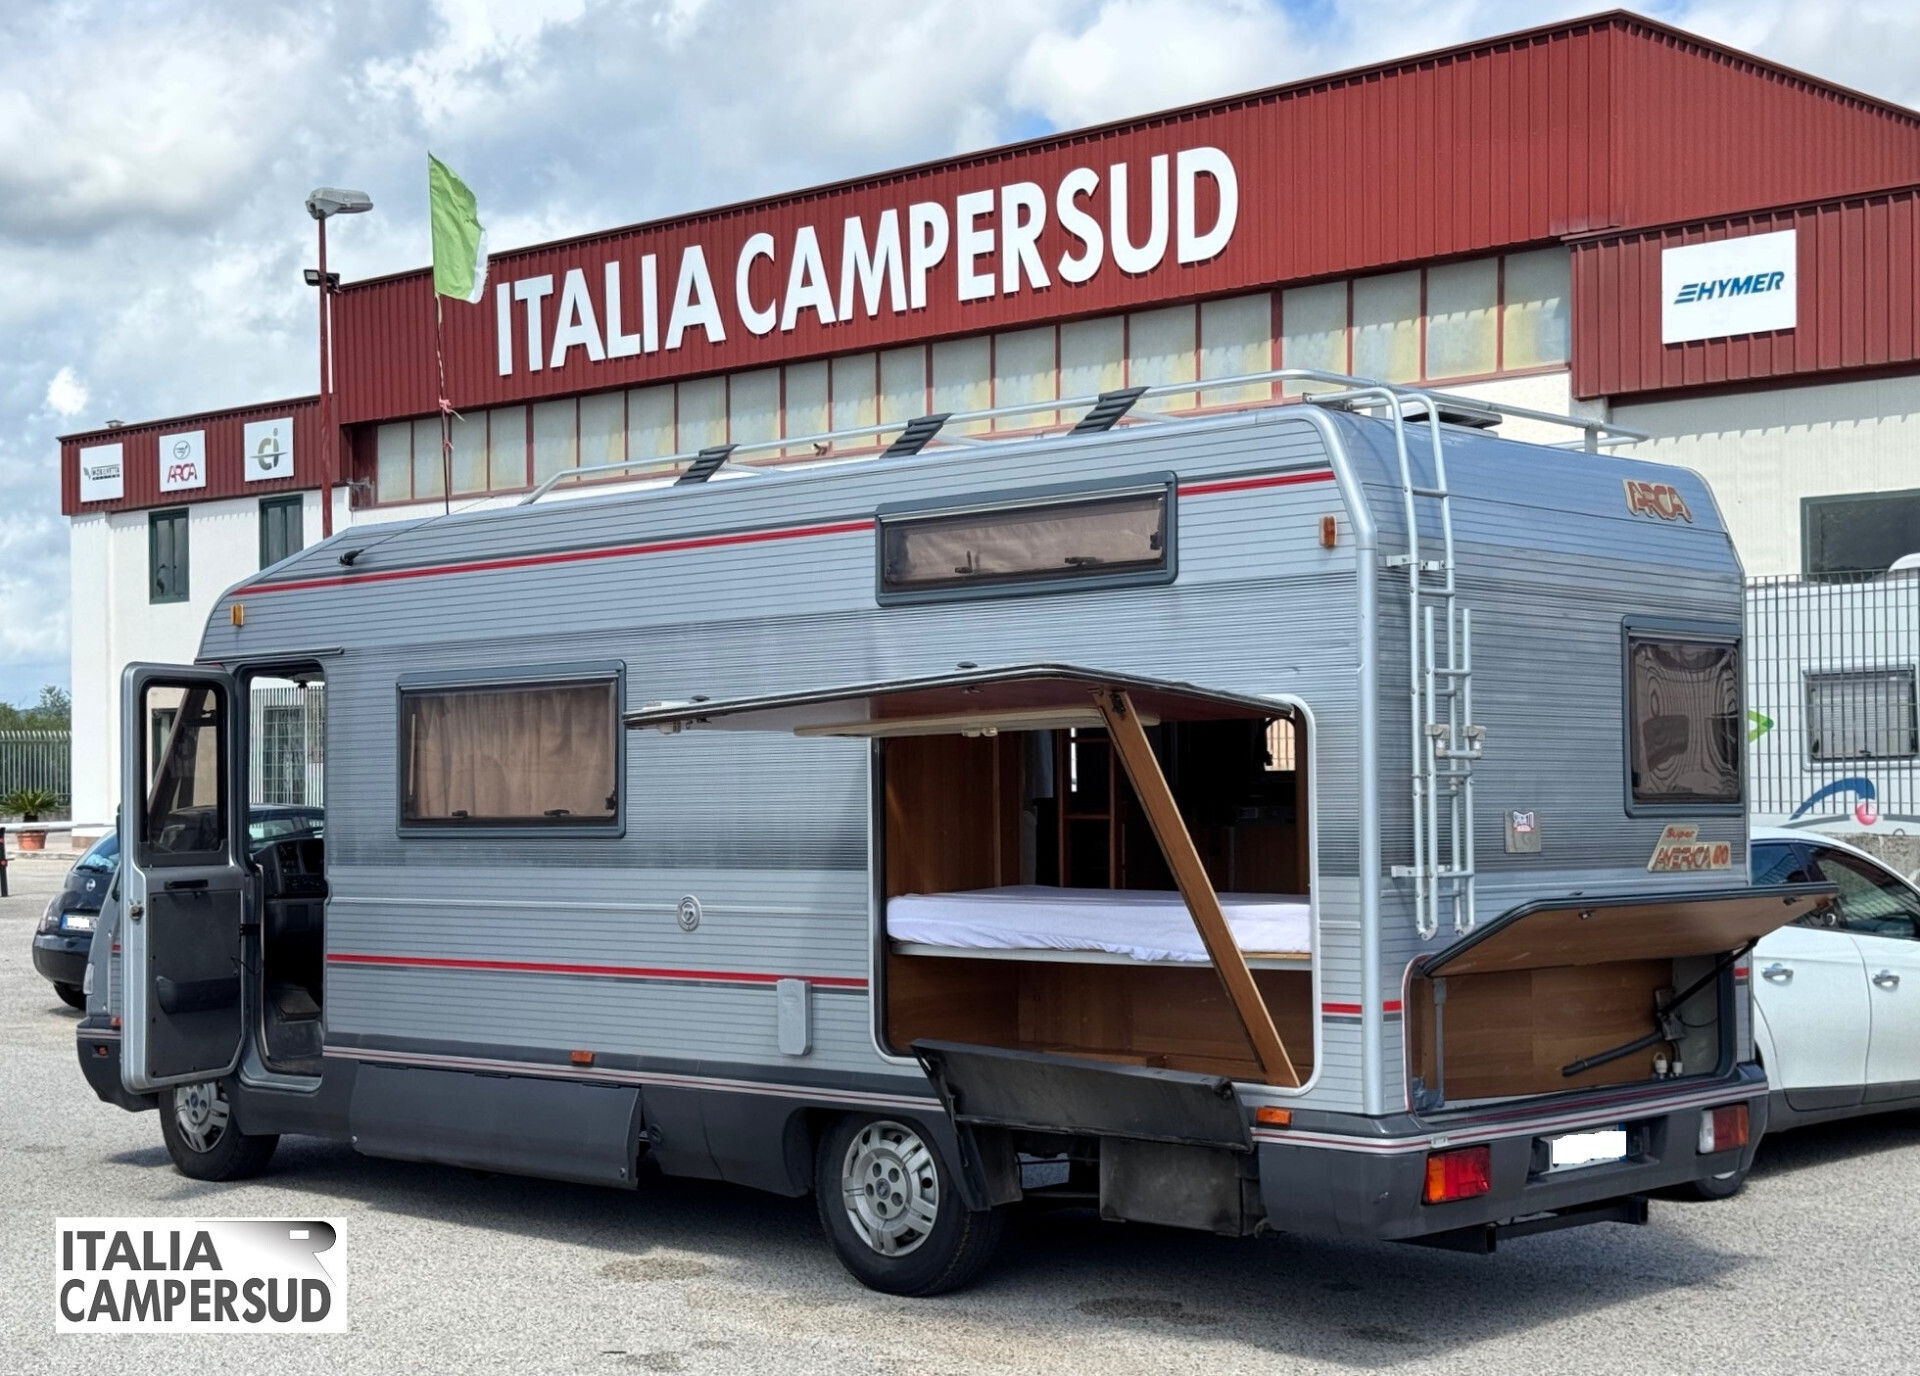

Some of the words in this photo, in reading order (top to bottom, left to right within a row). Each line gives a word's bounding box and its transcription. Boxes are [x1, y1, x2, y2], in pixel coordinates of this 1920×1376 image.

[497, 243, 726, 376] ITALIA
[736, 146, 1239, 335] CAMPERSUD
[1695, 271, 1785, 301] HYMER
[167, 463, 198, 483] ARCA
[1625, 481, 1692, 521] ARCA
[1666, 827, 1694, 841] Super
[1652, 846, 1711, 868] AMERICA
